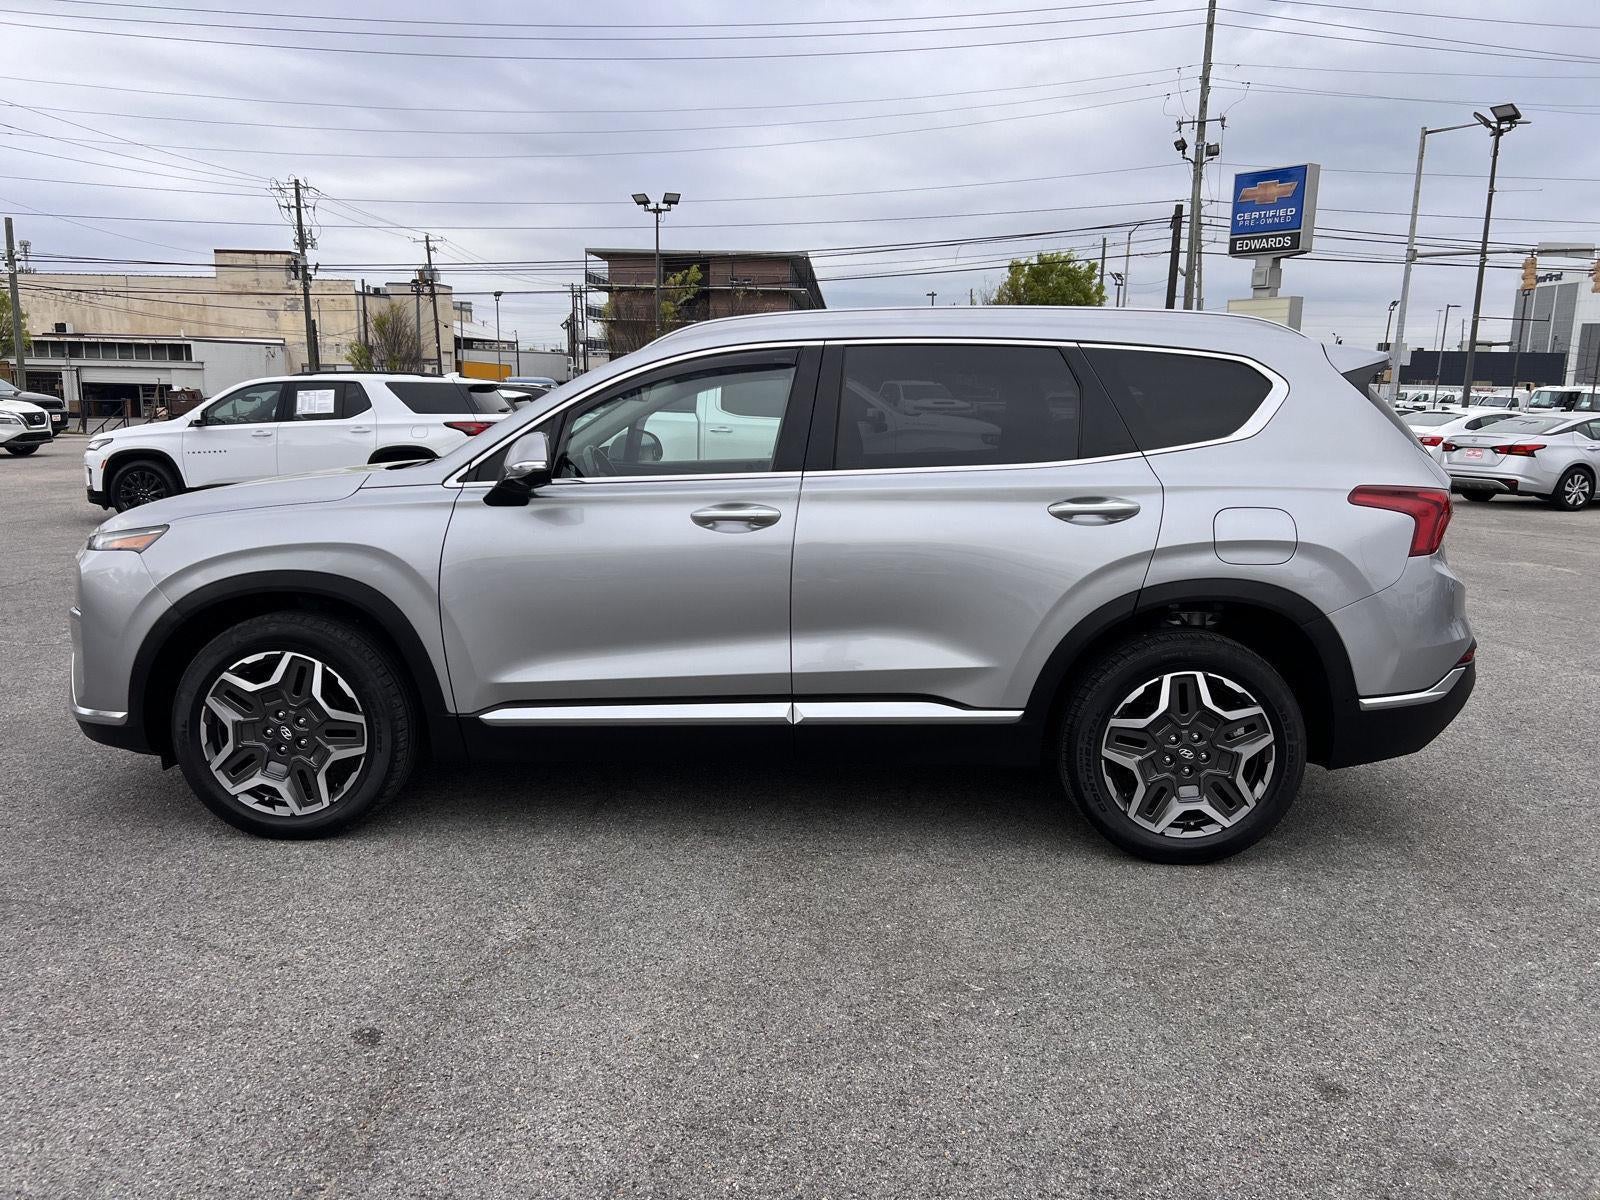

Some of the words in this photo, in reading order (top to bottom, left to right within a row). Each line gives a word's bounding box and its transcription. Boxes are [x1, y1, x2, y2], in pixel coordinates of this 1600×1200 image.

[1236, 207, 1296, 221] CERTIFIED
[1238, 215, 1292, 227] PRE-OWNED
[1236, 236, 1292, 251] EDWARDS
